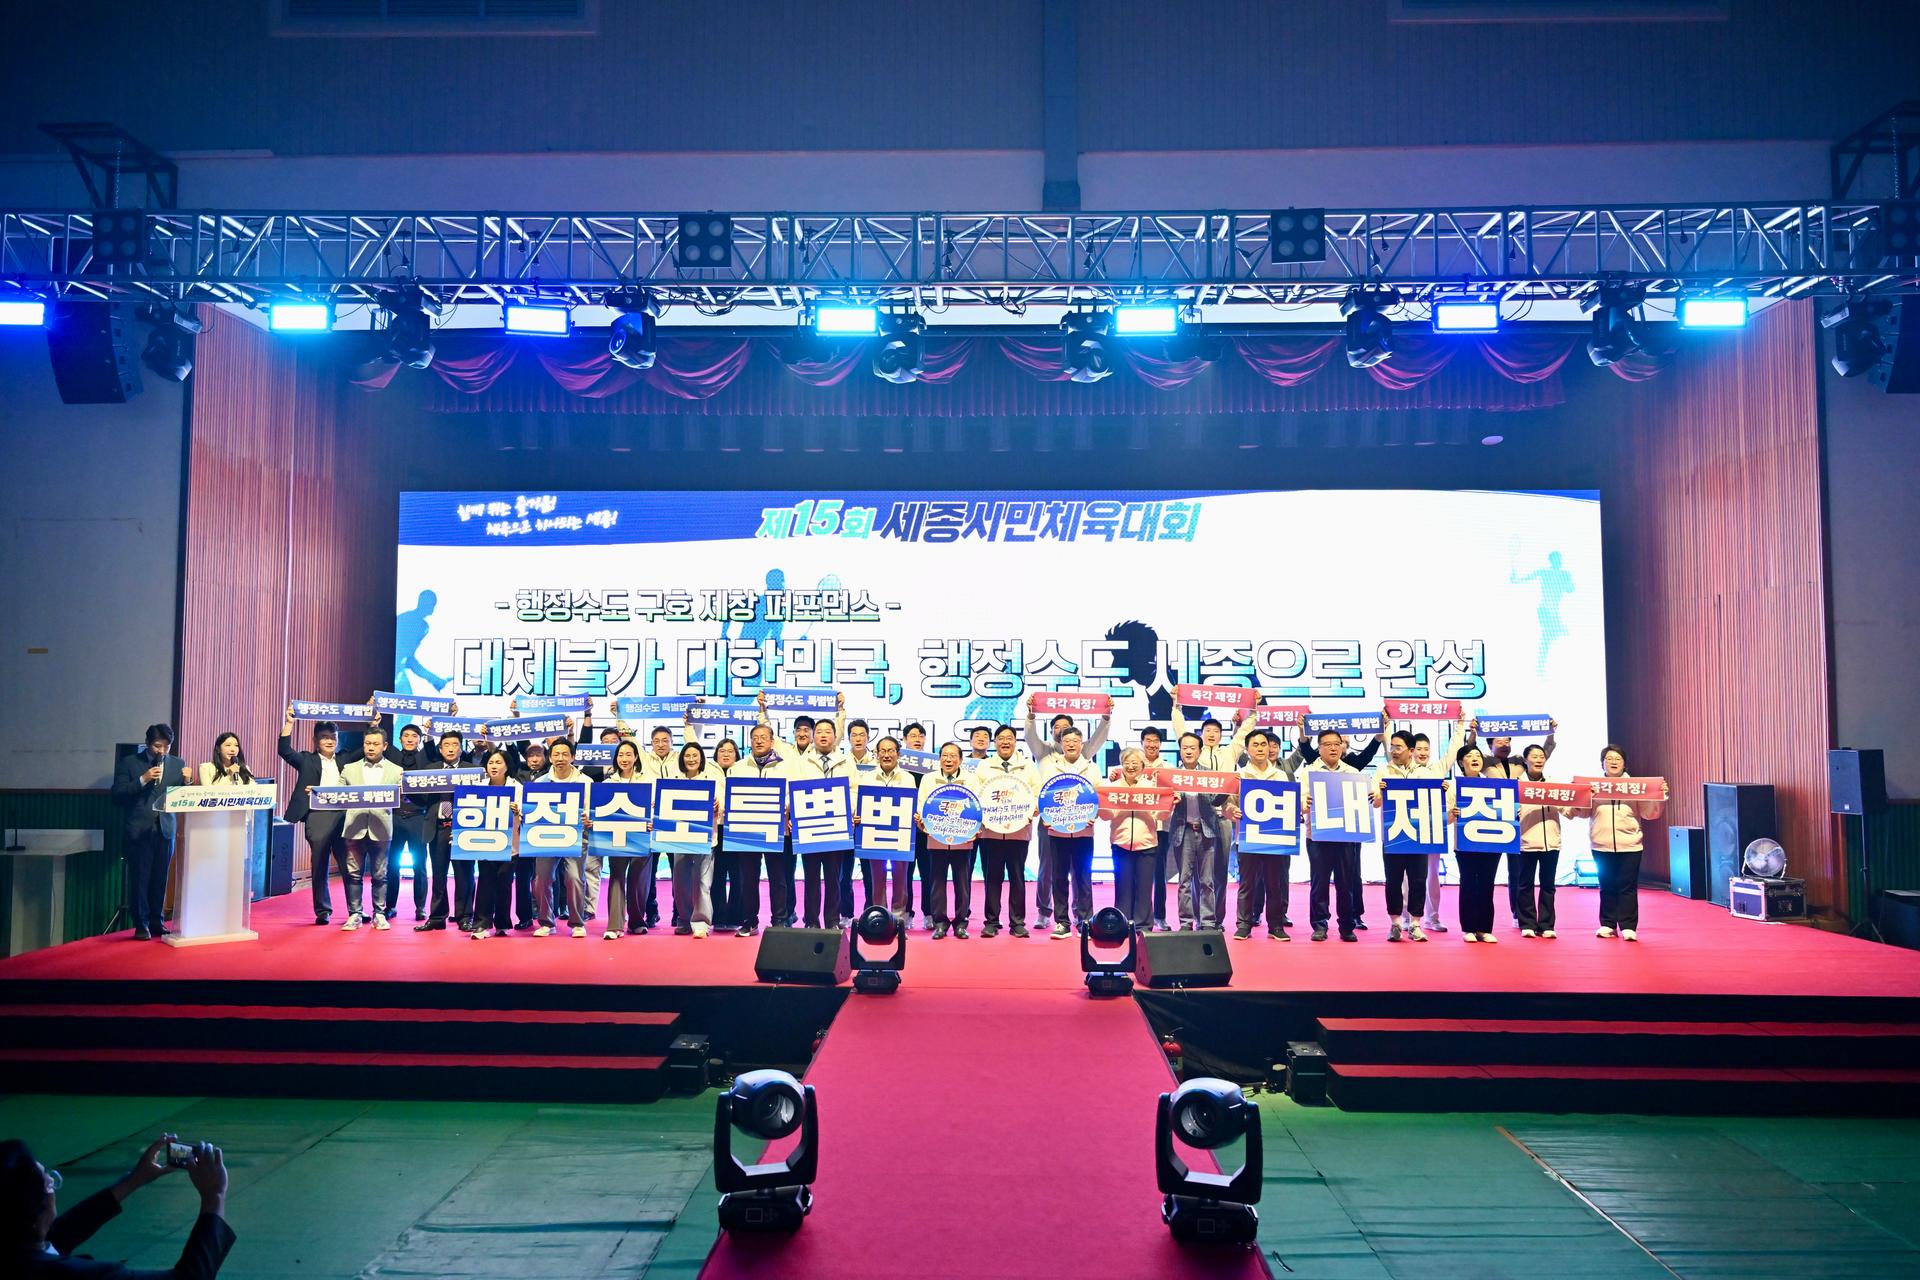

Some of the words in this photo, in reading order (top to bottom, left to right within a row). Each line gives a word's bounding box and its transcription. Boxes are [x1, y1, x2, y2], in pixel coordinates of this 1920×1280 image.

[757, 498, 876, 540] 제15회
[879, 500, 1202, 543] 세종시민체육대회
[516, 589, 630, 622] 행정수도
[636, 589, 694, 622] 구호
[699, 589, 758, 622] 제창
[764, 589, 880, 622] 퍼포먼스
[453, 638, 664, 698] 대체불가
[676, 638, 906, 704] 대한민국,
[918, 638, 1134, 698] 행정수도
[1146, 638, 1363, 698] 세종으로
[1375, 638, 1487, 699] 완성
[765, 694, 804, 706] 행정수도
[807, 695, 837, 707] 특별법
[1191, 690, 1213, 702] 즉각
[1214, 691, 1242, 704] 제정!
[297, 702, 340, 715] 행정수도
[343, 705, 374, 717] 특별법
[378, 697, 418, 710] 행정수도
[420, 700, 450, 713] 특별법
[625, 703, 660, 713] 행정수도
[662, 703, 689, 712] 특별법
[1046, 698, 1068, 709] 즉각
[1069, 698, 1097, 710] 제정!
[1398, 703, 1420, 715] 즉각
[1421, 703, 1448, 715] 제정!
[690, 708, 730, 720] 행정수도
[1273, 710, 1299, 722] 제정!
[433, 721, 471, 734] 행정수도
[490, 724, 532, 738] 행정수도
[534, 719, 565, 733] 특별법
[1307, 718, 1349, 731] 행정수도
[1350, 717, 1380, 730] 특별법
[1479, 720, 1519, 733] 행정수도
[1521, 718, 1550, 732] 특별법
[407, 775, 448, 788] 행정수도
[1171, 774, 1194, 787] 즉각
[1196, 776, 1225, 788] 제정!
[1523, 788, 1546, 800] 즉각
[1548, 788, 1576, 801] 제정!
[1615, 782, 1647, 795] 제정!
[170, 799, 196, 808] 제15회
[197, 797, 273, 808] 세종시민체육대회
[316, 791, 360, 804] 행정수도
[363, 790, 395, 803] 특별법
[1107, 792, 1130, 805] 즉각
[1132, 792, 1160, 805] 제정!
